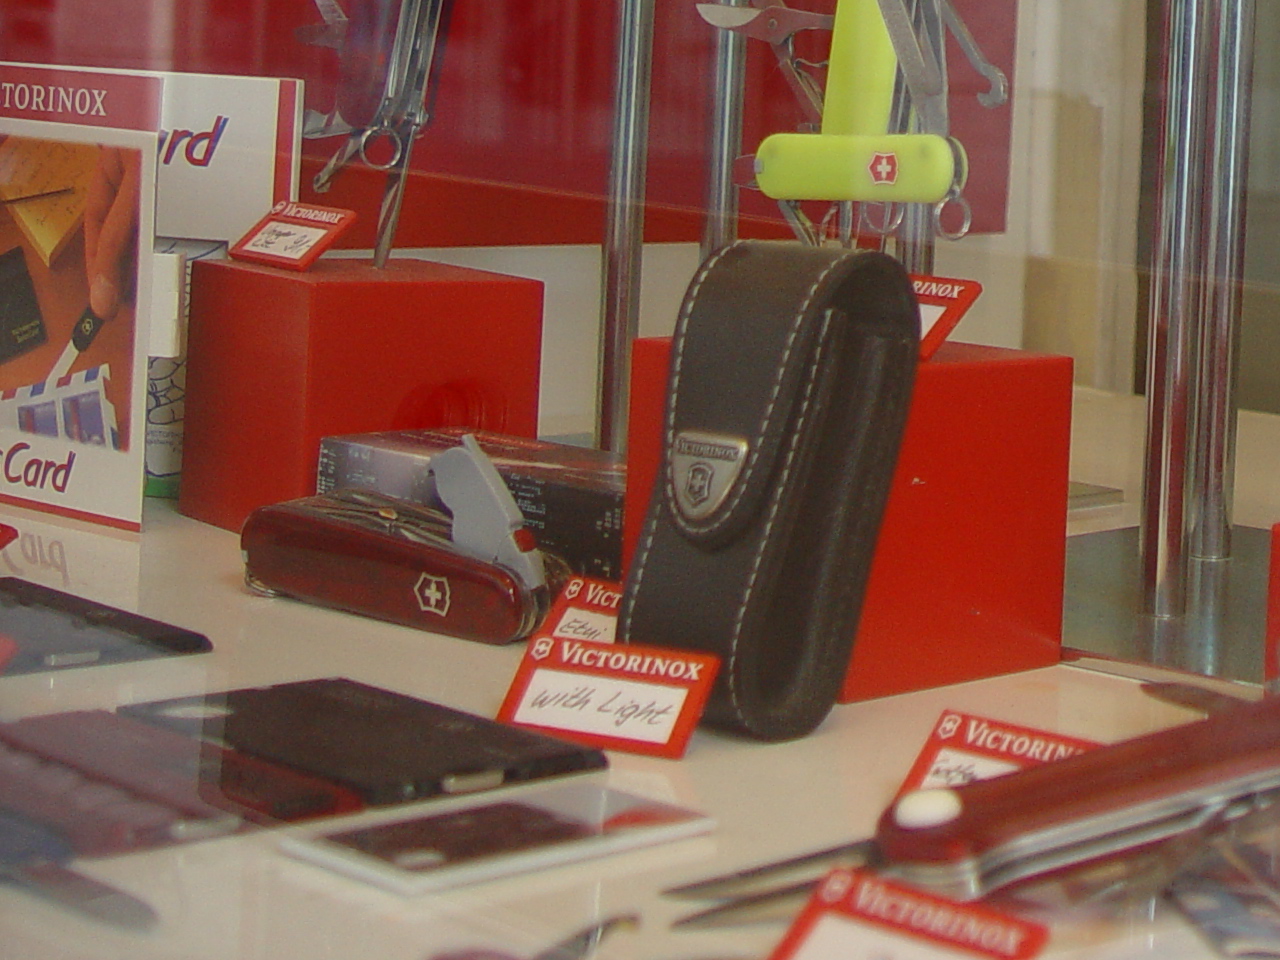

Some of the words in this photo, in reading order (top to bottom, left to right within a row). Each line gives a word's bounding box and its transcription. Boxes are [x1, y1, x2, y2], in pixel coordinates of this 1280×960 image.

[0, 83, 107, 117] TORINOX
[283, 203, 345, 224] VICTORINOX
[0, 441, 76, 493] Card
[586, 583, 623, 609] VICT
[561, 641, 704, 681] VICTORINOX
[597, 691, 673, 727] Light
[966, 719, 1085, 762] VICTORIN
[857, 880, 1027, 956] VICTORINOX
